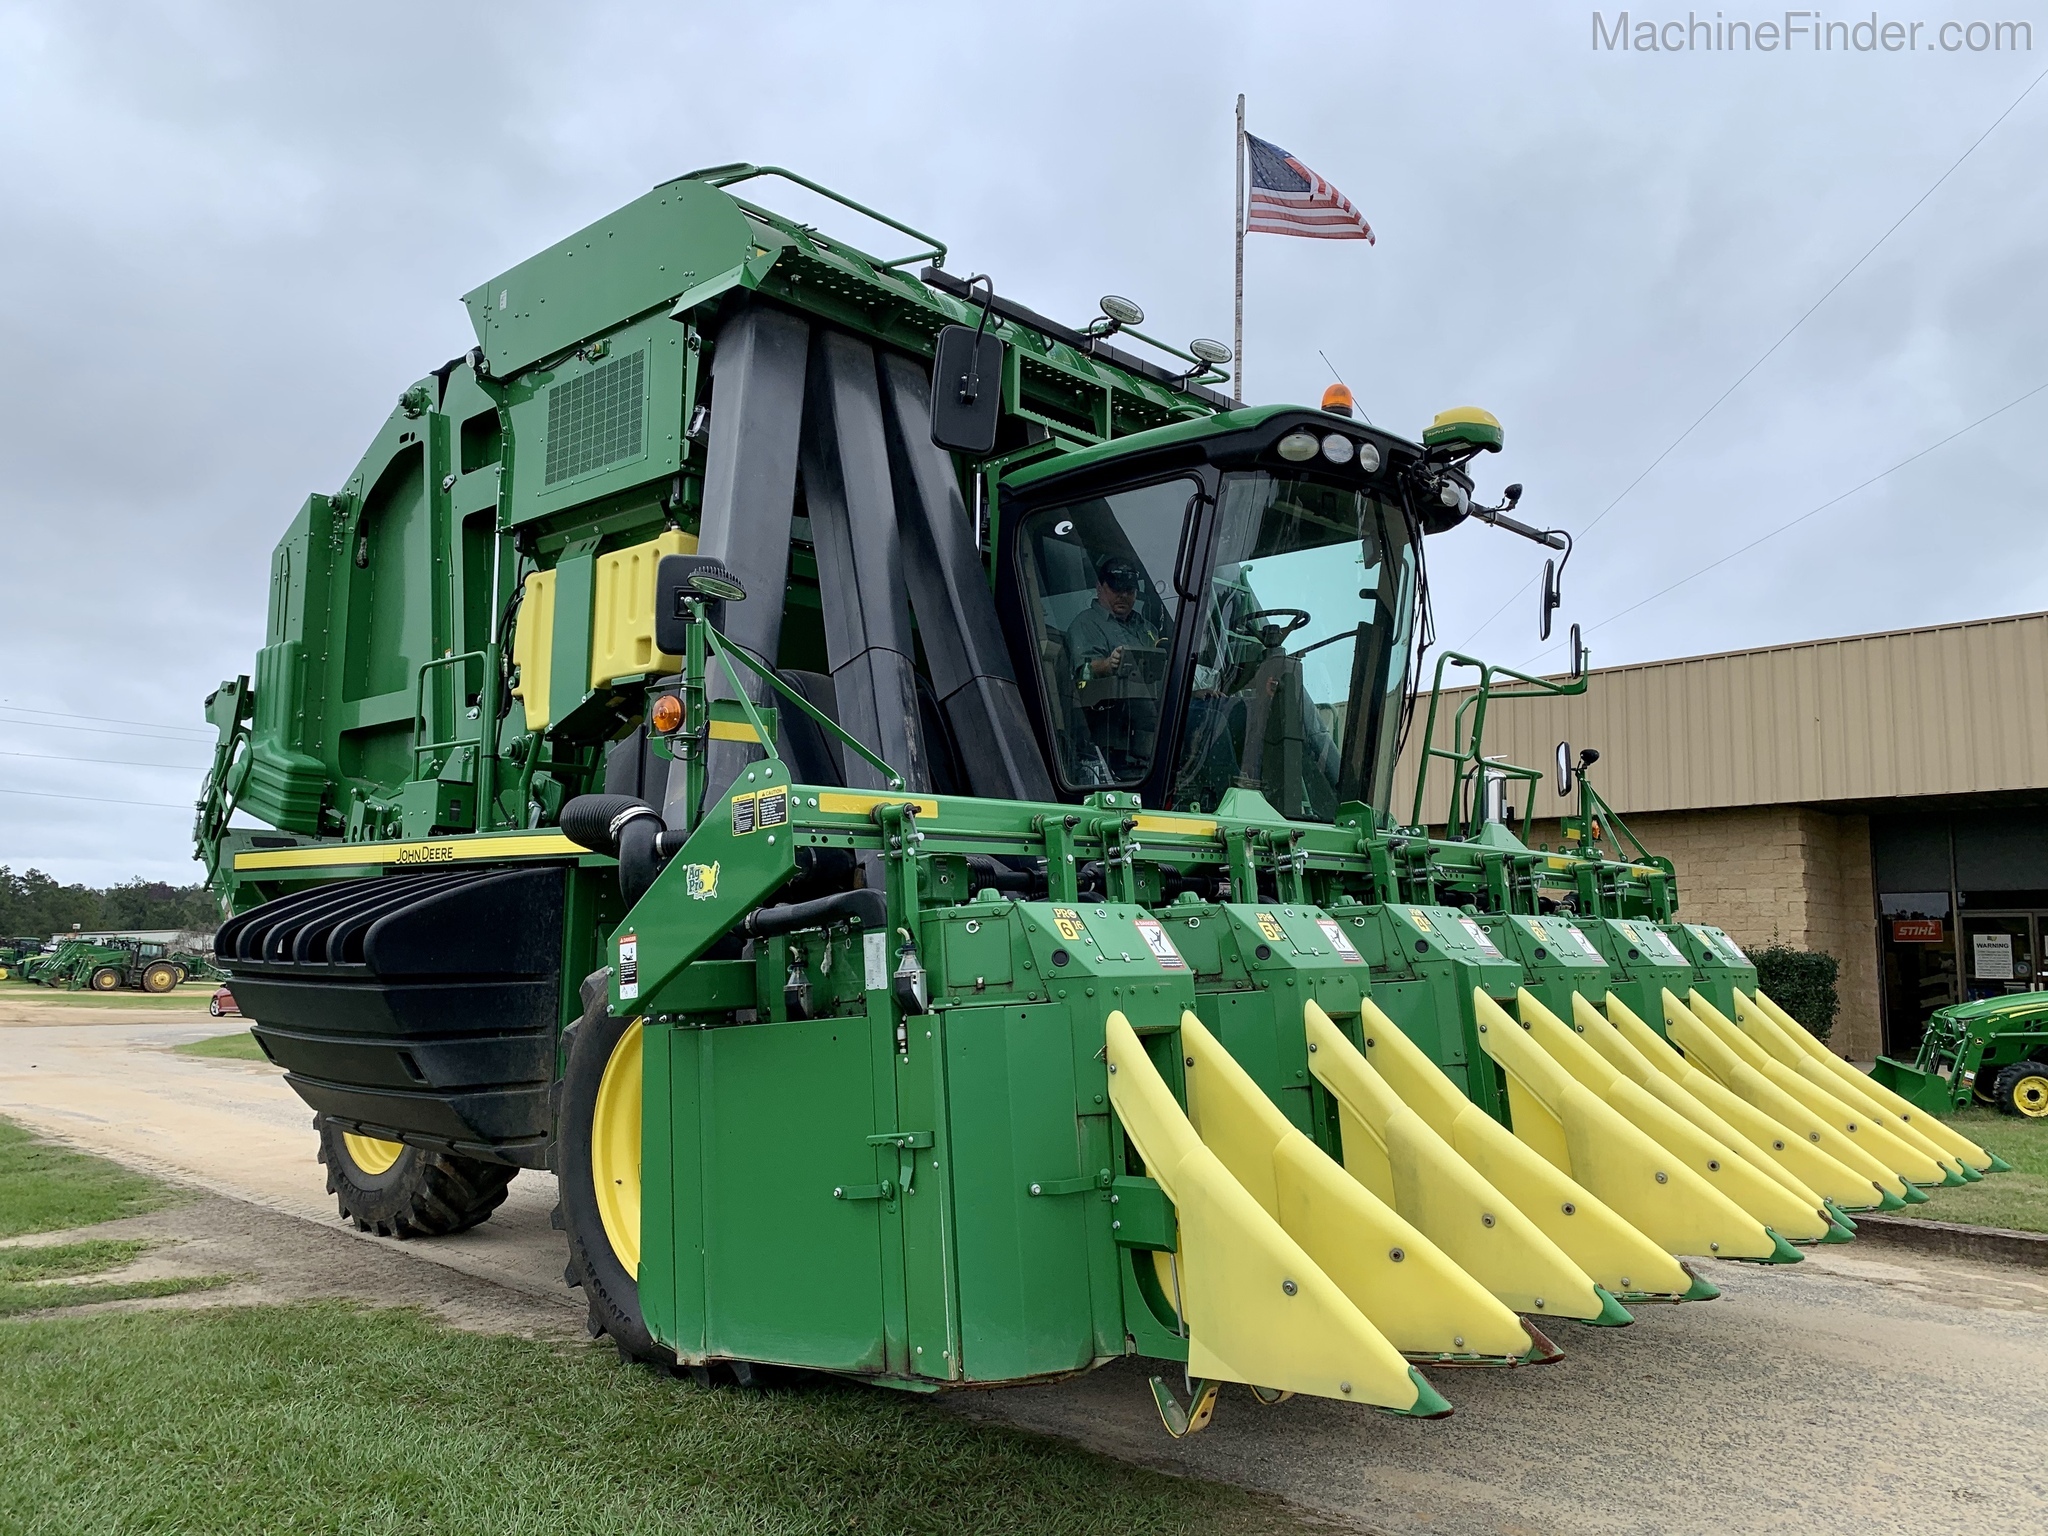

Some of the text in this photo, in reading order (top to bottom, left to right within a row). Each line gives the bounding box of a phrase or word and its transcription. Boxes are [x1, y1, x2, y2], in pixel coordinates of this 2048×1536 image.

[766, 788, 782, 796] CAUTION
[689, 880, 704, 892] Pro
[1060, 922, 1074, 937] 6
[1263, 925, 1275, 938] 5
[1898, 926, 1936, 936] STIHL
